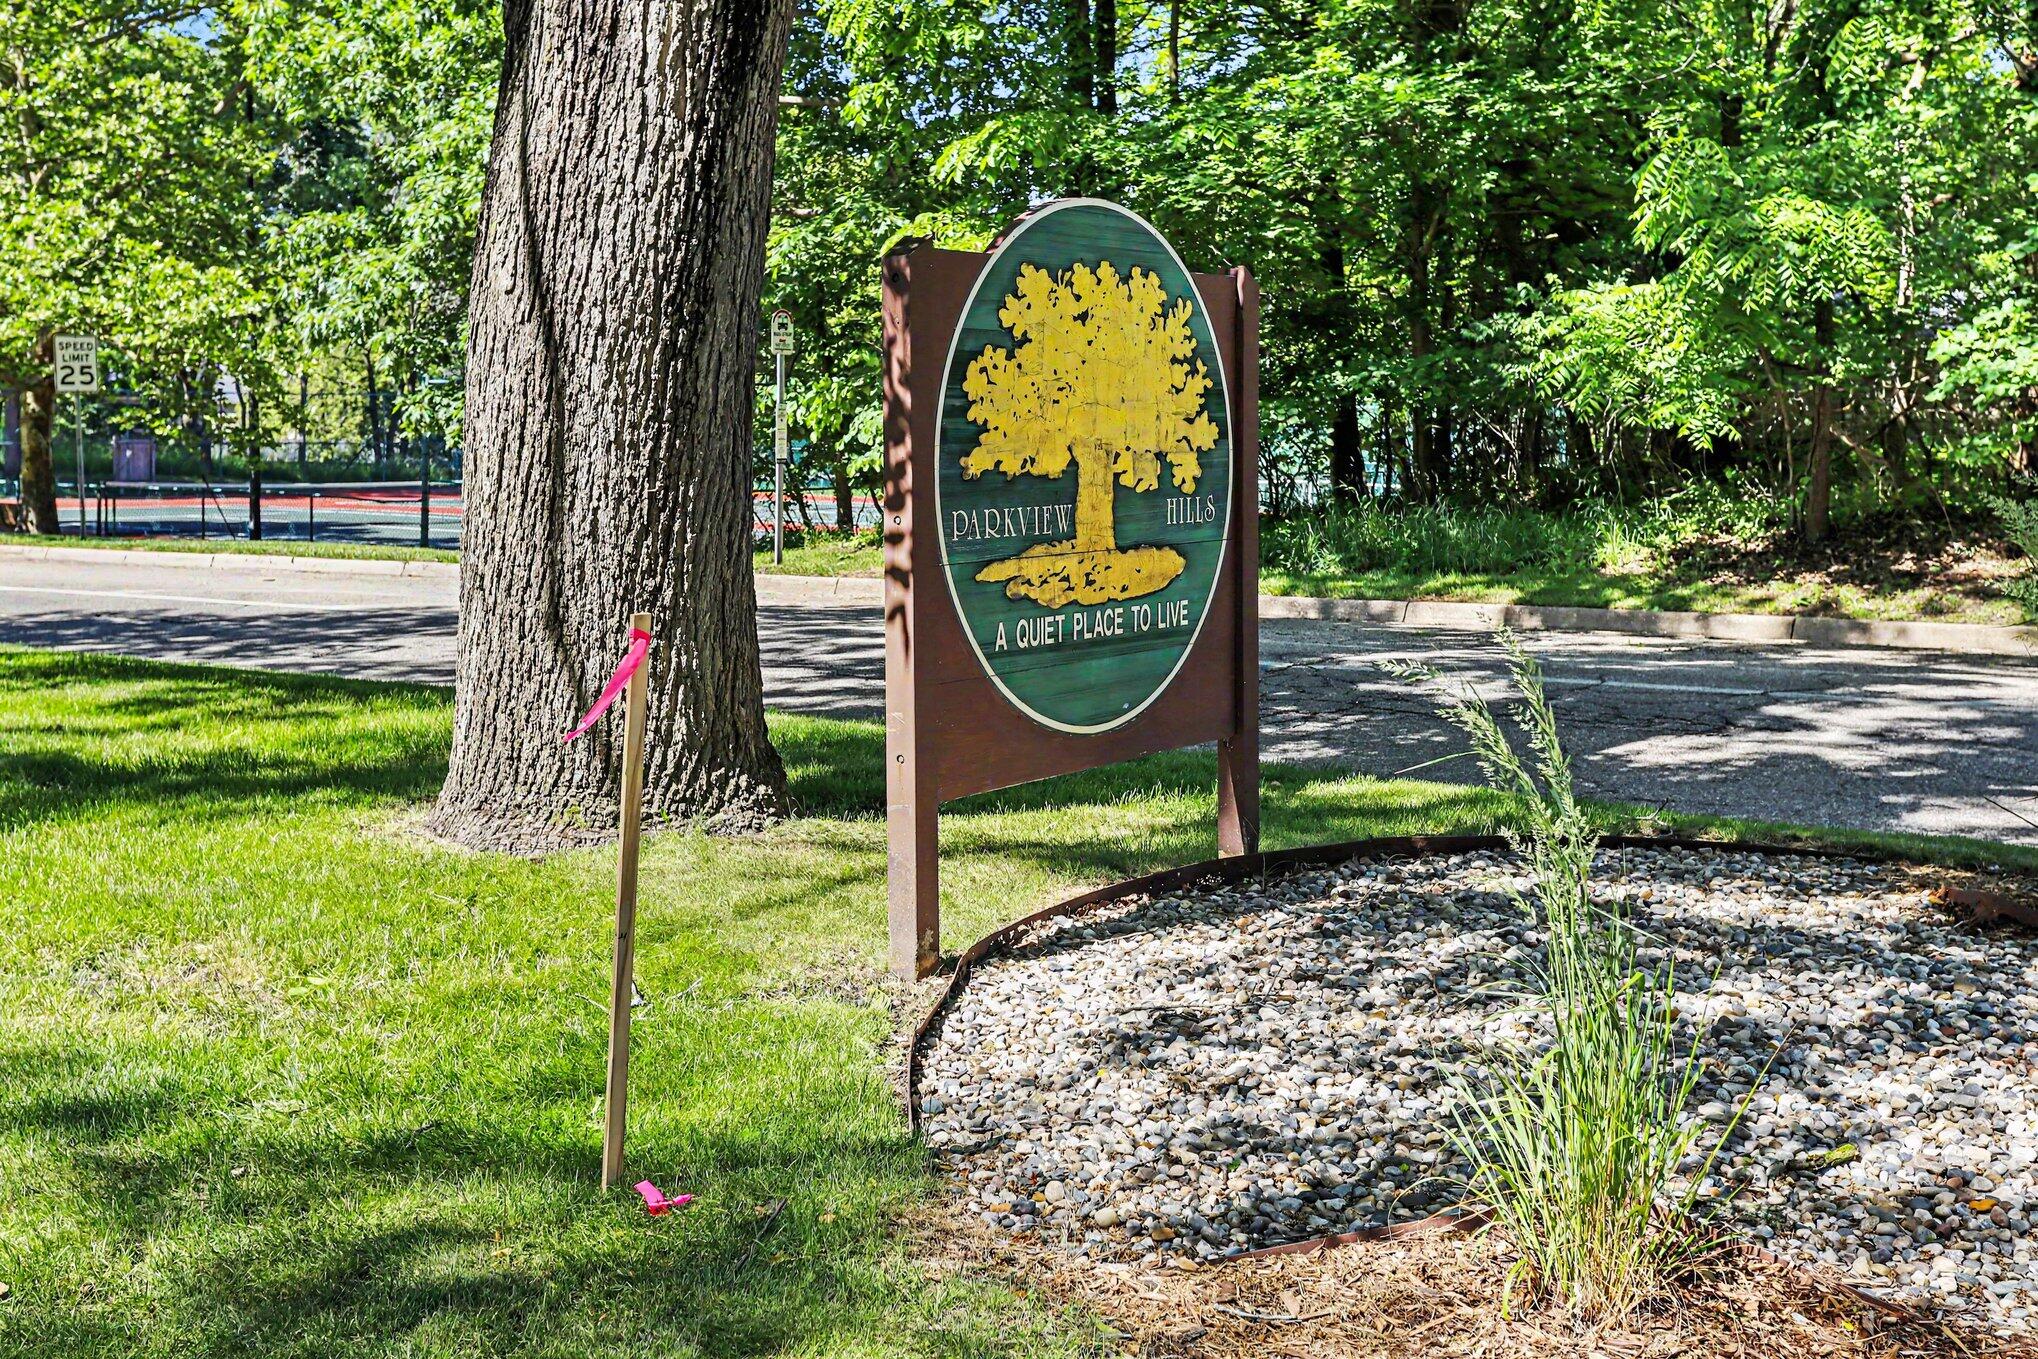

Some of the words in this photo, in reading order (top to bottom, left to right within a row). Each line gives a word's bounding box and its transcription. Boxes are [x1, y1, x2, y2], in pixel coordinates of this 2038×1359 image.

[58, 341, 93, 351] SPEED
[62, 354, 89, 362] LIMIT
[60, 365, 94, 385] 25
[952, 504, 1072, 541] PARKVIEW
[1166, 494, 1216, 525] HILLS
[995, 622, 1008, 652] A
[1016, 614, 1066, 649] QUIET
[1073, 607, 1124, 641] PLACE
[1131, 604, 1151, 632] TO
[1158, 599, 1189, 629] LIVE
